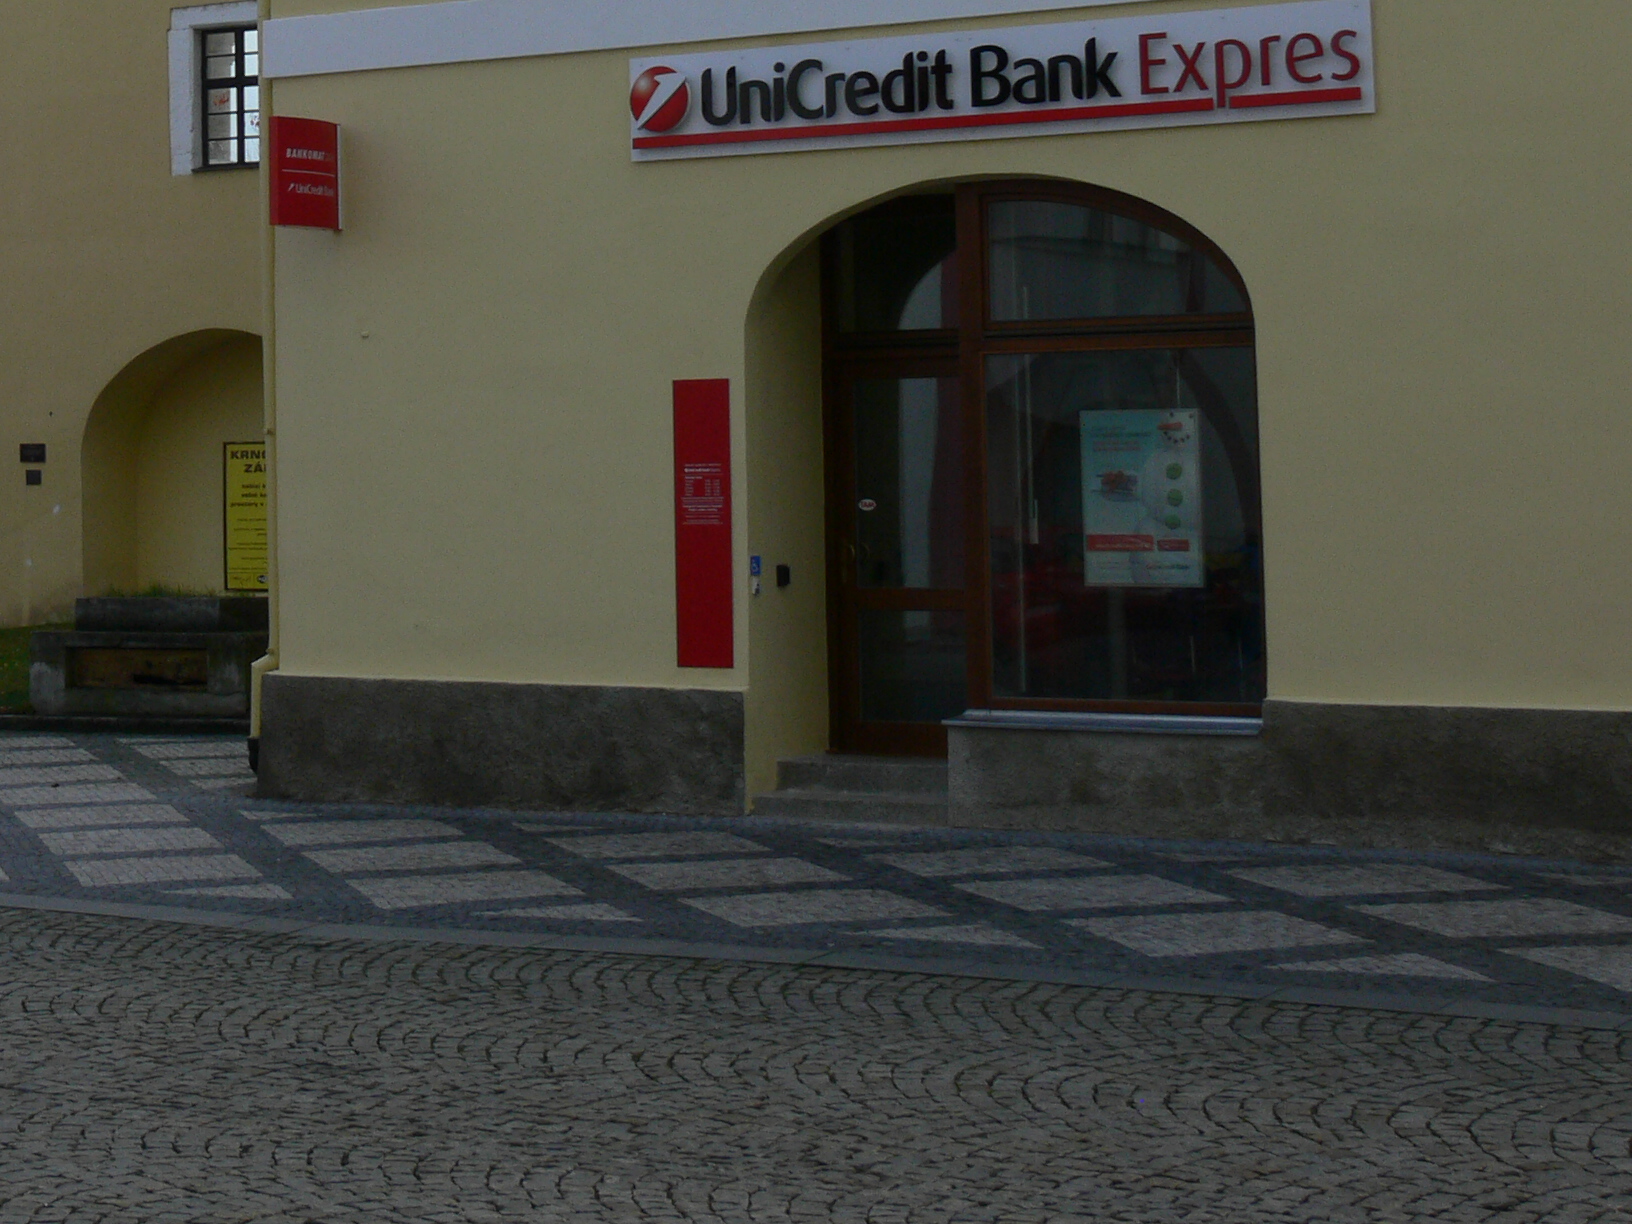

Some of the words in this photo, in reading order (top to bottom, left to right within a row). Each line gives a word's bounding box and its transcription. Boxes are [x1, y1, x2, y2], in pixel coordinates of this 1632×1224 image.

[701, 48, 953, 126] UniCredit
[970, 37, 1122, 108] Bank
[1137, 29, 1361, 108] Expres
[244, 461, 266, 473] ZÁ
